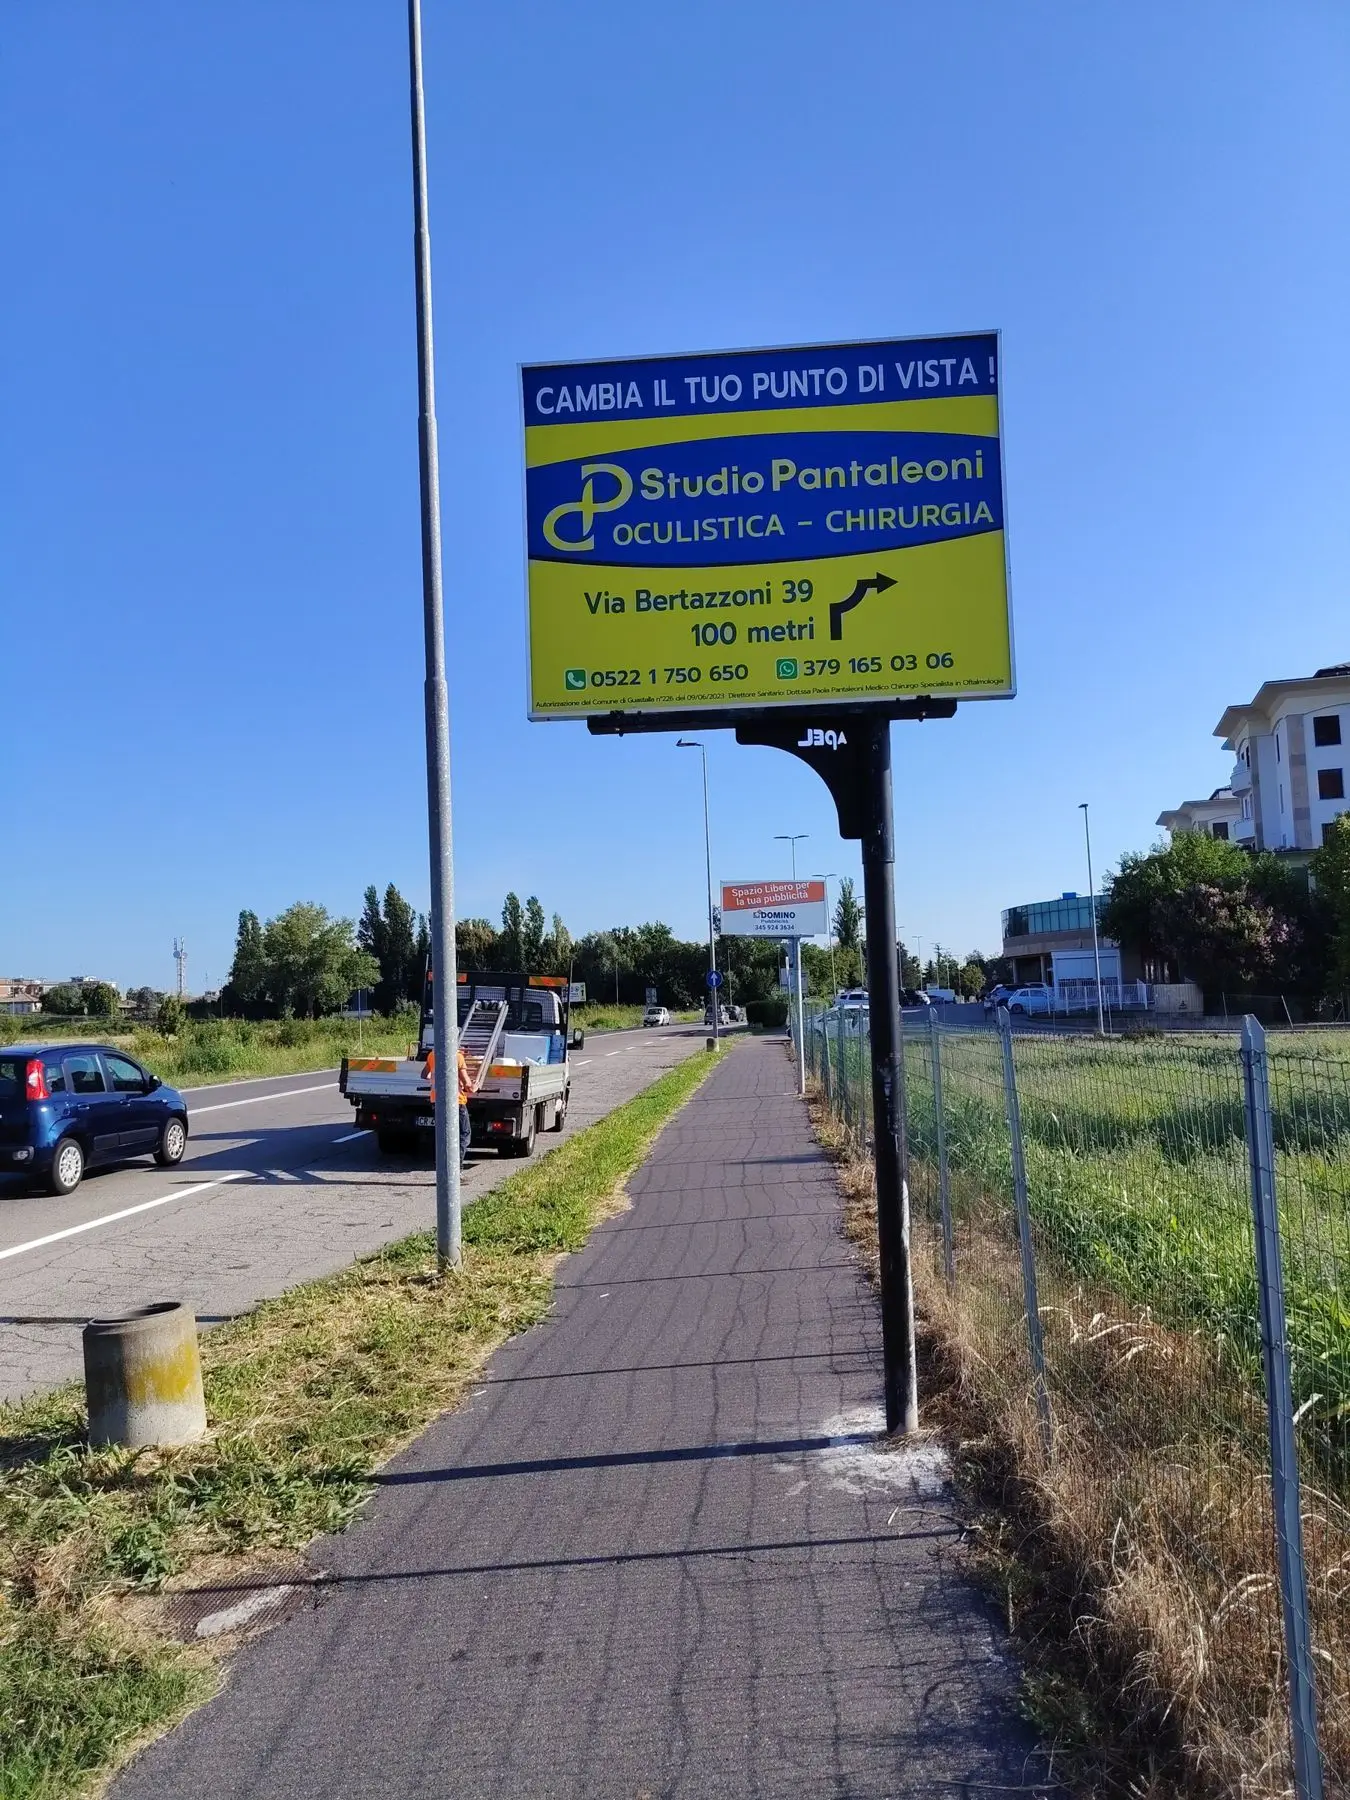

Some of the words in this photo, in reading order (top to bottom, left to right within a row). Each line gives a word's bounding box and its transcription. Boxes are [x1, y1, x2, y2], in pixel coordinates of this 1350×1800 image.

[536, 382, 643, 415] CAMBIA
[654, 380, 675, 407] IL
[684, 374, 742, 404] TUO
[753, 367, 848, 400] PUNTO
[858, 365, 884, 392] DI
[895, 357, 978, 388] VISTA
[640, 465, 764, 500] Studio
[771, 450, 984, 491] Pantaleoni
[612, 513, 785, 545] OCULISTICA
[825, 501, 994, 533] CHIRURGIA
[584, 592, 626, 616] Via
[635, 581, 772, 613] Bertazzoni
[781, 579, 814, 603] 39
[691, 621, 737, 647] 100
[747, 617, 814, 644] metri
[591, 670, 641, 688] 0522
[649, 669, 656, 685] 1
[663, 666, 700, 683] 750
[709, 663, 749, 681] 650
[803, 659, 840, 676] 379
[849, 657, 882, 674] 165
[890, 655, 918, 672] 03
[926, 652, 954, 669] 06
[920, 681, 953, 689] Specialista
[732, 888, 762, 898] Spazio
[765, 884, 793, 892] Libero
[796, 882, 810, 891] per
[736, 898, 744, 906] la
[748, 897, 761, 905] tua
[764, 891, 808, 904] pubblicità
